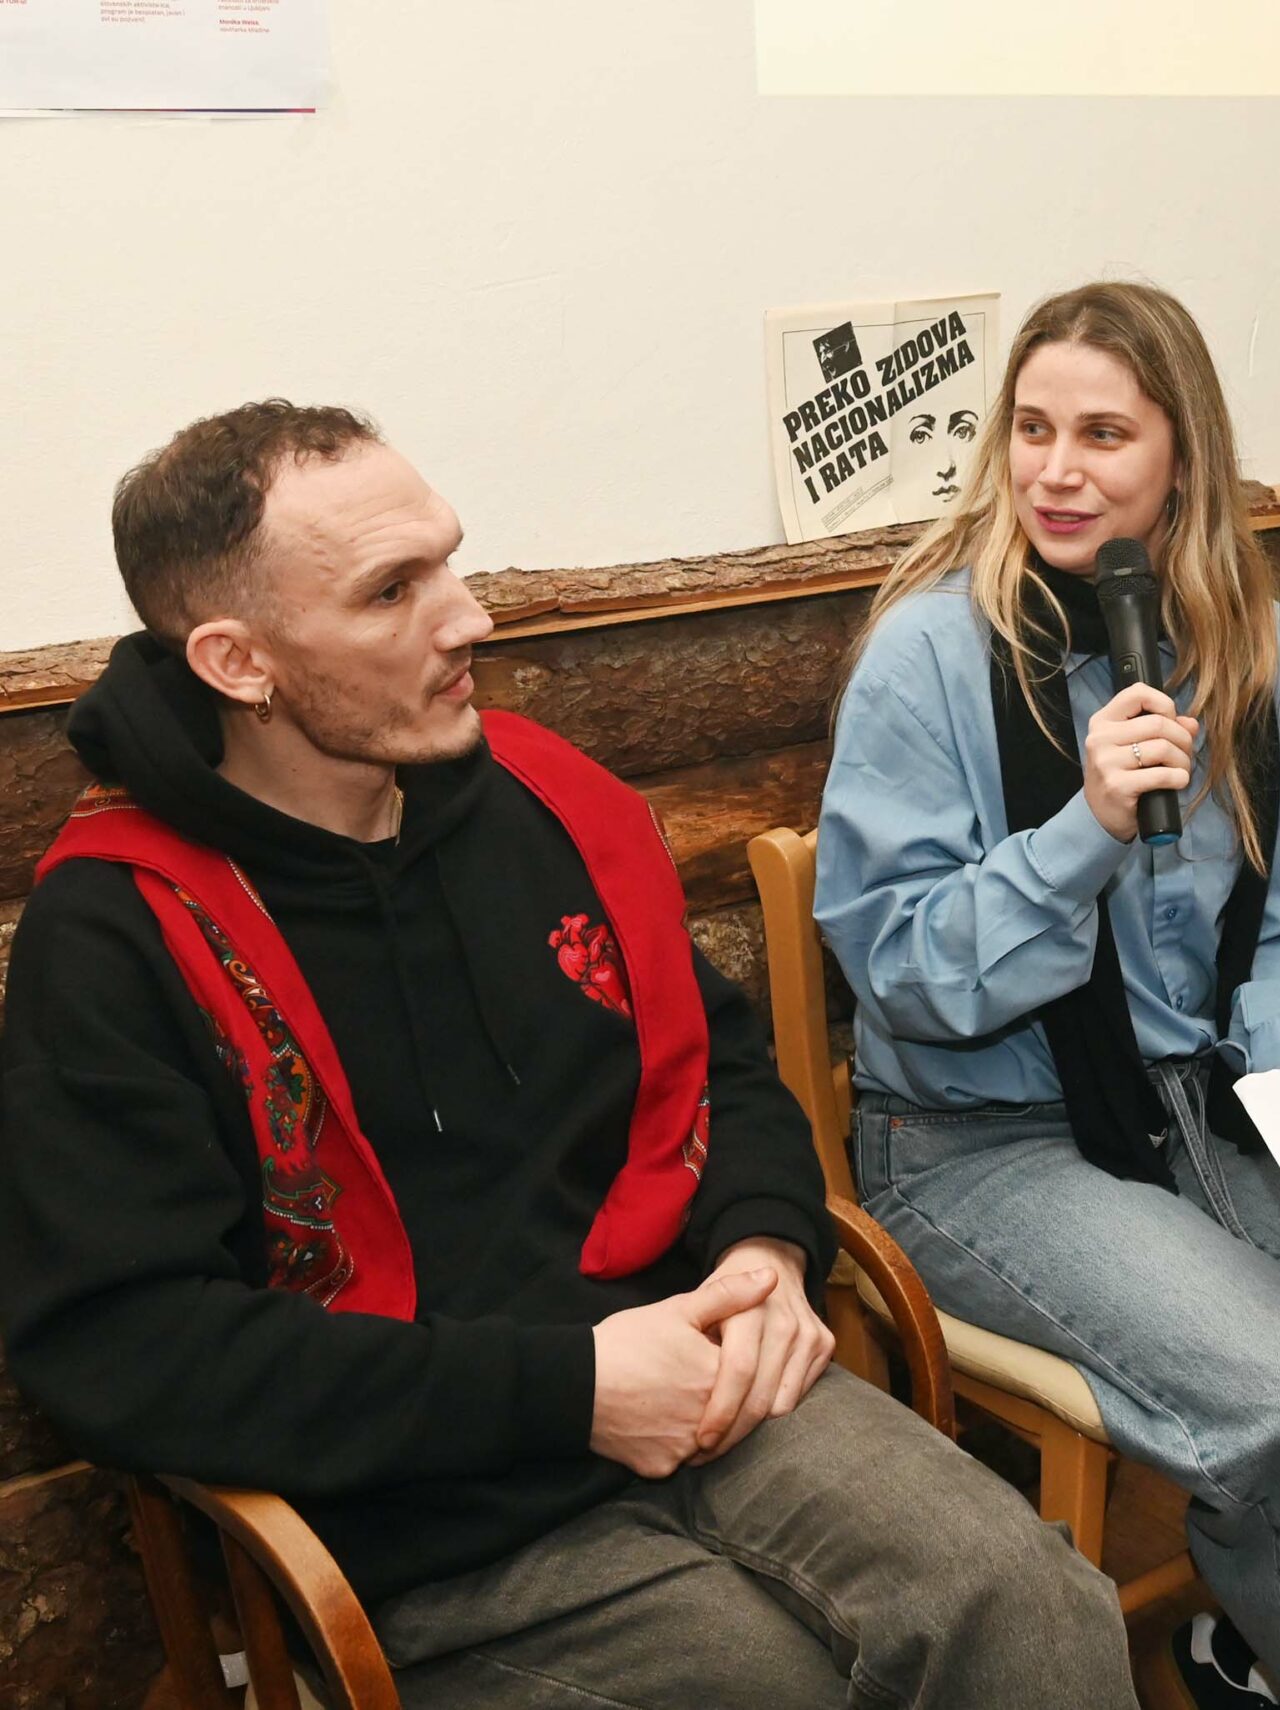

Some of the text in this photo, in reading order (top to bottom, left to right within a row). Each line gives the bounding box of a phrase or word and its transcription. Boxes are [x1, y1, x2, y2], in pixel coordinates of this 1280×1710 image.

[783, 310, 967, 443] PREKO ZIDOVA
[792, 339, 976, 475] NACIONALIZMA
[804, 476, 820, 505] I
[818, 431, 889, 494] RATA
